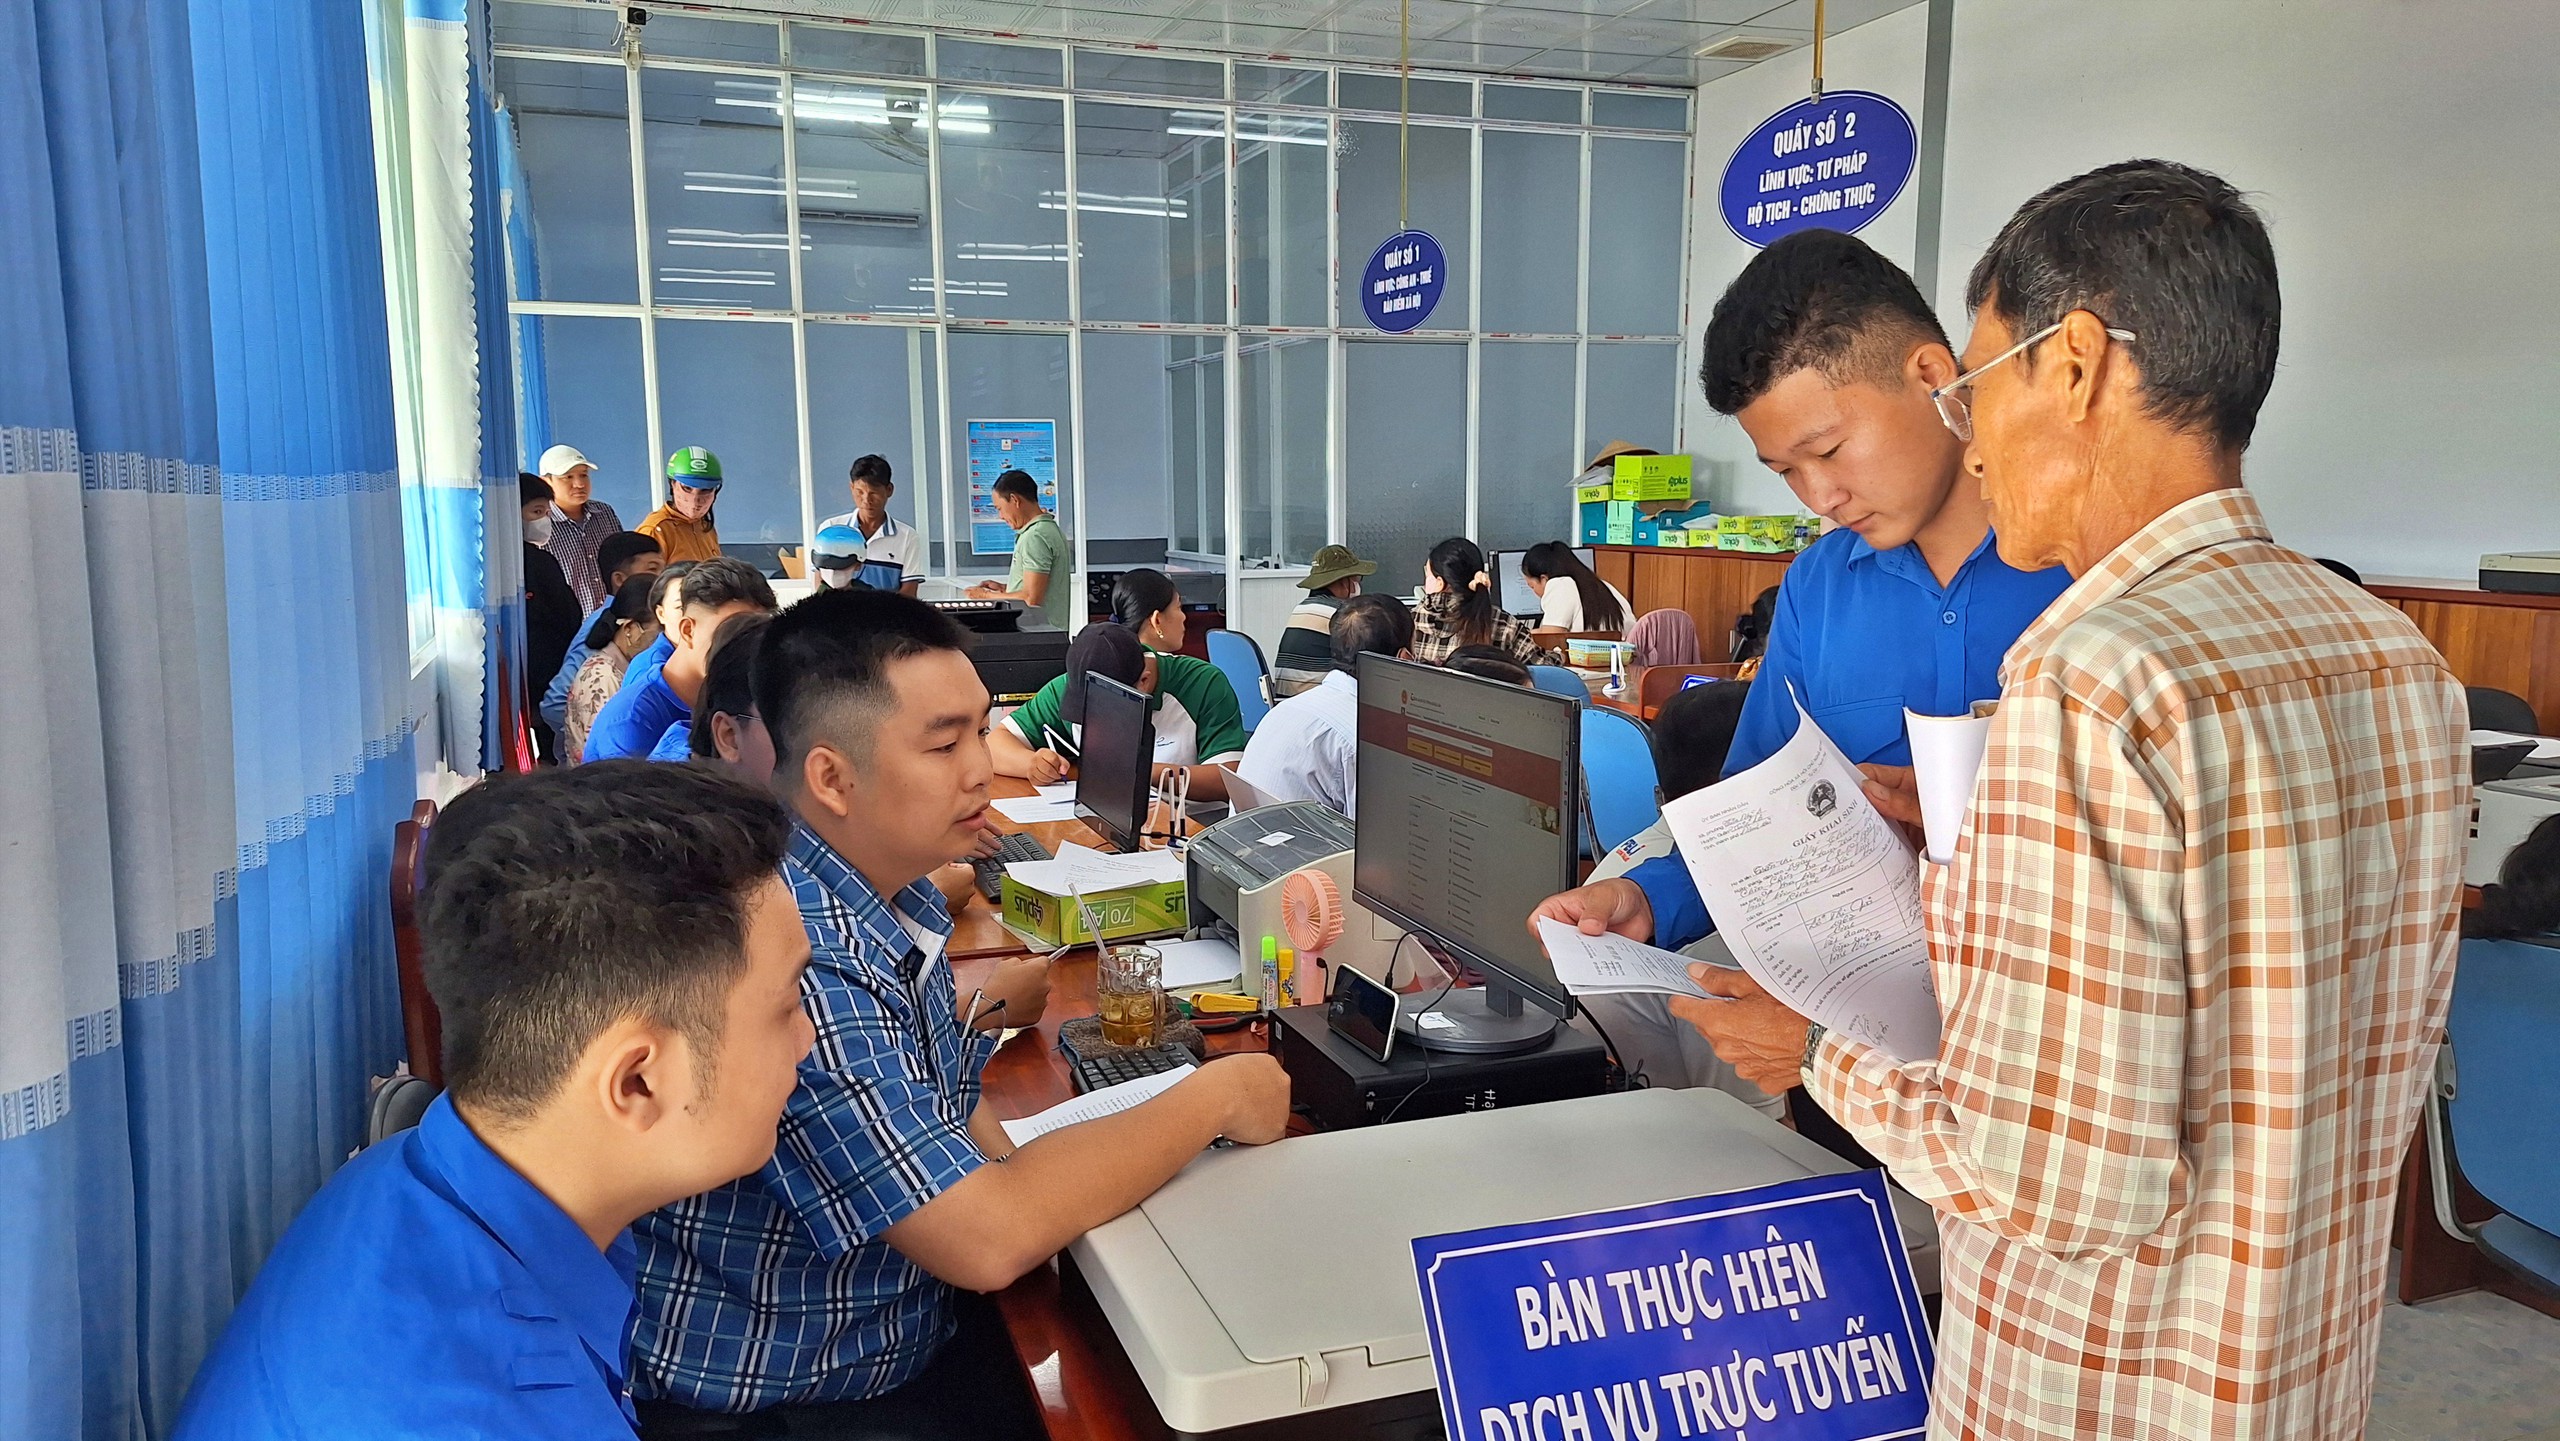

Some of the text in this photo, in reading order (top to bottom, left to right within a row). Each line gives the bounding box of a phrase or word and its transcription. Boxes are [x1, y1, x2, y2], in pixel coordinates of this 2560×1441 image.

[1773, 109, 1856, 158] QUẦY SỐ 2
[1759, 149, 1868, 193] LĨNH VỰC: TƯ PHÁP
[1747, 201, 1763, 228] HỘ
[1765, 200, 1791, 226] TỊCH
[1800, 189, 1841, 216] CHỨNG
[1843, 182, 1876, 209] THỰC
[1415, 244, 1420, 262] 1
[1819, 816, 1842, 835] KHAI
[1110, 908, 1132, 924] 70
[1164, 895, 1186, 913] us
[1515, 1224, 1828, 1351] BÀN THỰC HIỆN
[1659, 1349, 1778, 1441] TRỰC
[1772, 1315, 1908, 1414] TUYẾN
